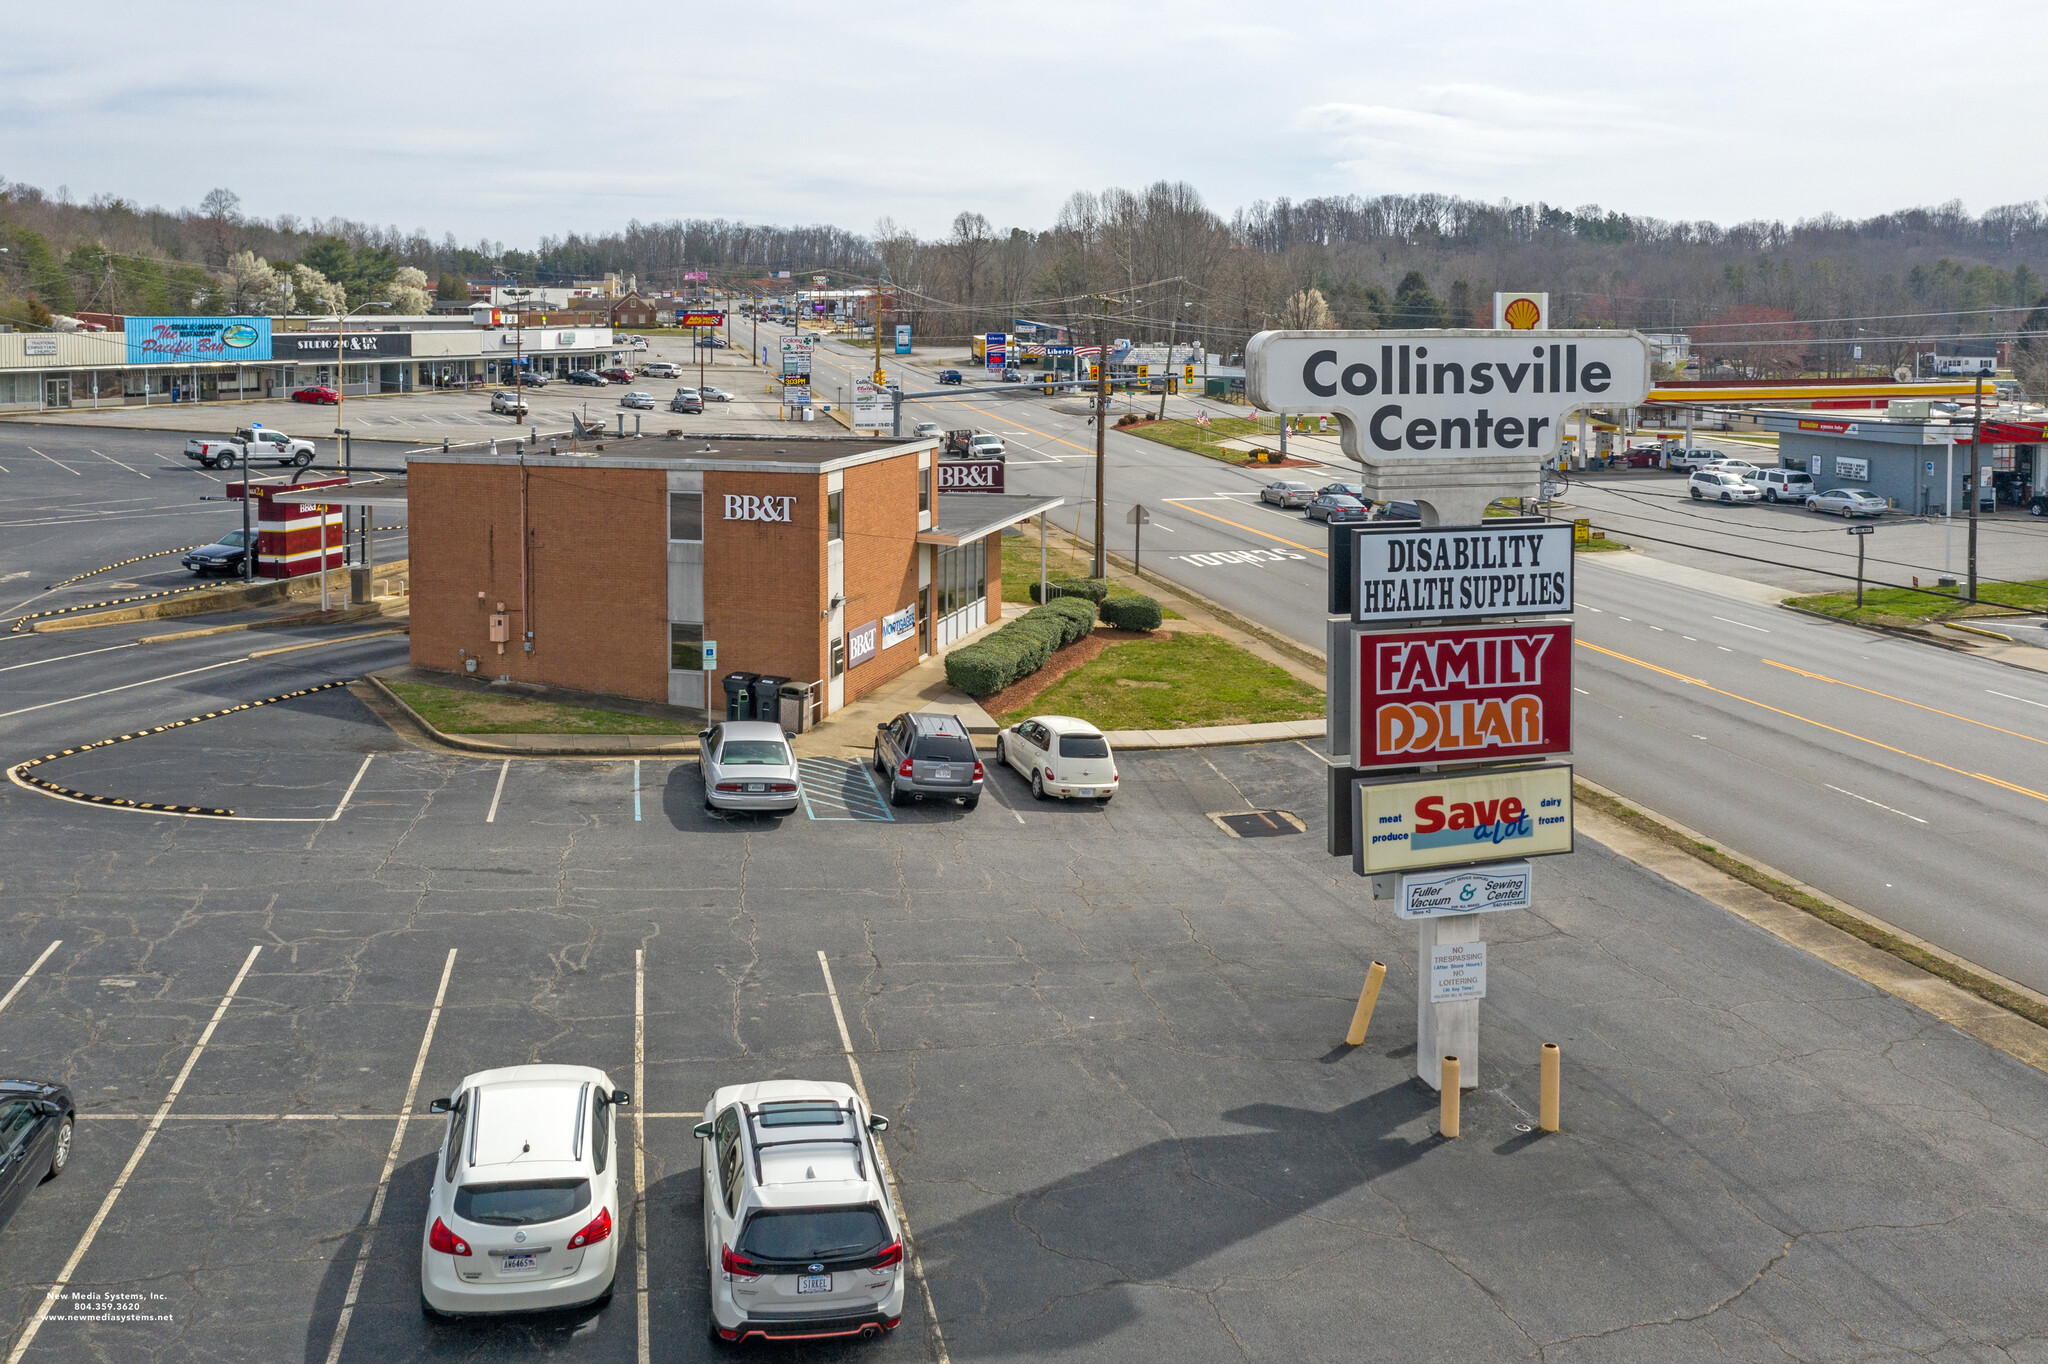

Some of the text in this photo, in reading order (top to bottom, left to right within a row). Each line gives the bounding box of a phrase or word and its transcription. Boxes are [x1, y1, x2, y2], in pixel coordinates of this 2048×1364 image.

[152, 324, 178, 340] The
[142, 338, 225, 357] Pacific Bay
[297, 340, 332, 349] STUDIO
[350, 337, 362, 350] &
[1302, 344, 1611, 398] Collinsville
[1369, 404, 1549, 451] Center
[938, 465, 999, 487] BB&T
[723, 494, 797, 522] BB&T
[1387, 534, 1544, 573] DISABILITY
[1364, 571, 1565, 613] HEALTH SUPPLIES
[882, 612, 914, 637] MORTGAGES
[850, 628, 876, 660] BB&T
[1376, 633, 1554, 695] FAMILY
[1376, 693, 1543, 756] DOLLAR
[1540, 798, 1562, 809] dairy
[1379, 813, 1402, 824] meat
[1414, 795, 1522, 834] Save
[1538, 815, 1565, 825] frozen
[1372, 832, 1409, 844] produce
[1412, 887, 1443, 897] Fuller
[1459, 883, 1477, 901] &
[1485, 880, 1524, 891] Sewing
[1411, 897, 1451, 908] Vacuum
[1487, 890, 1524, 900] Center
[1435, 953, 1483, 963] TRESPASSING
[1439, 977, 1478, 986] LOITERING
[803, 1279, 827, 1289] SIRKEL
